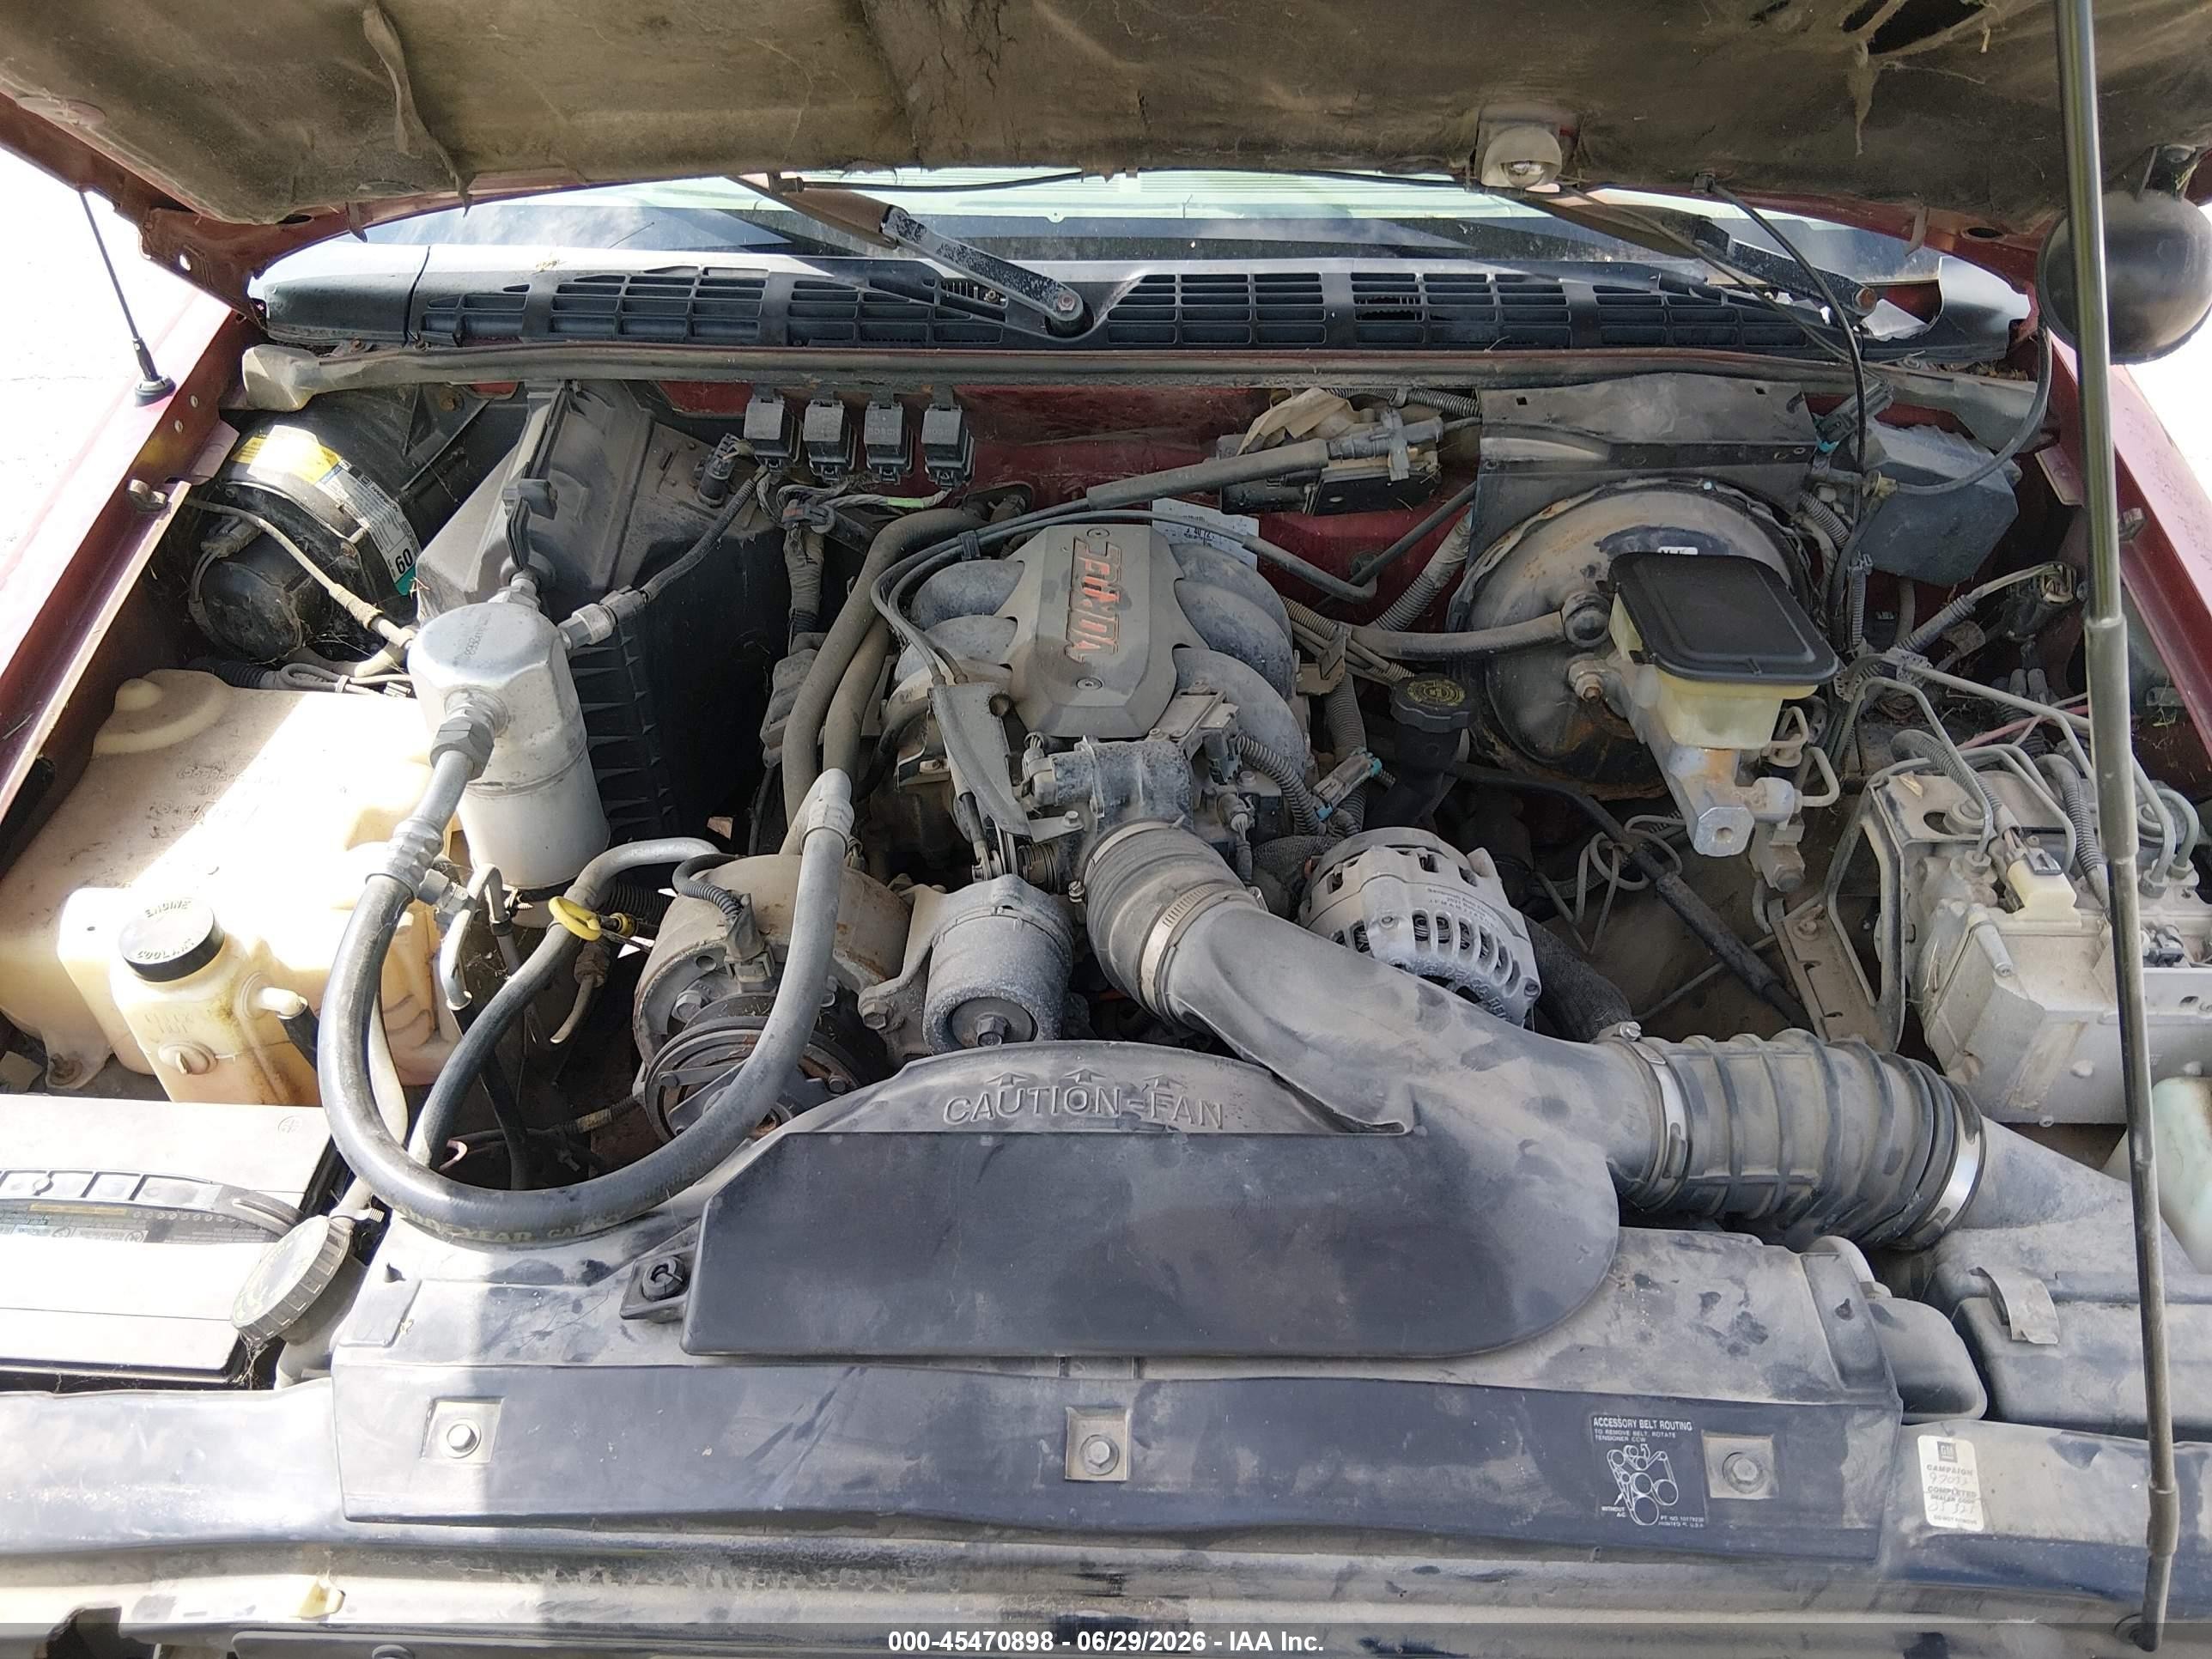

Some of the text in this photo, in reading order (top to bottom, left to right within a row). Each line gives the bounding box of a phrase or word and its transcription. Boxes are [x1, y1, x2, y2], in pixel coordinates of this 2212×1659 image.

[396, 549, 414, 574] 60
[144, 899, 191, 918] ENGINE
[1593, 1417, 1692, 1431] ACCESSORY BELT ROUTING
[1926, 1464, 1972, 1476] CAMPAIGN
[1928, 1486, 1977, 1498] COMPLETED
